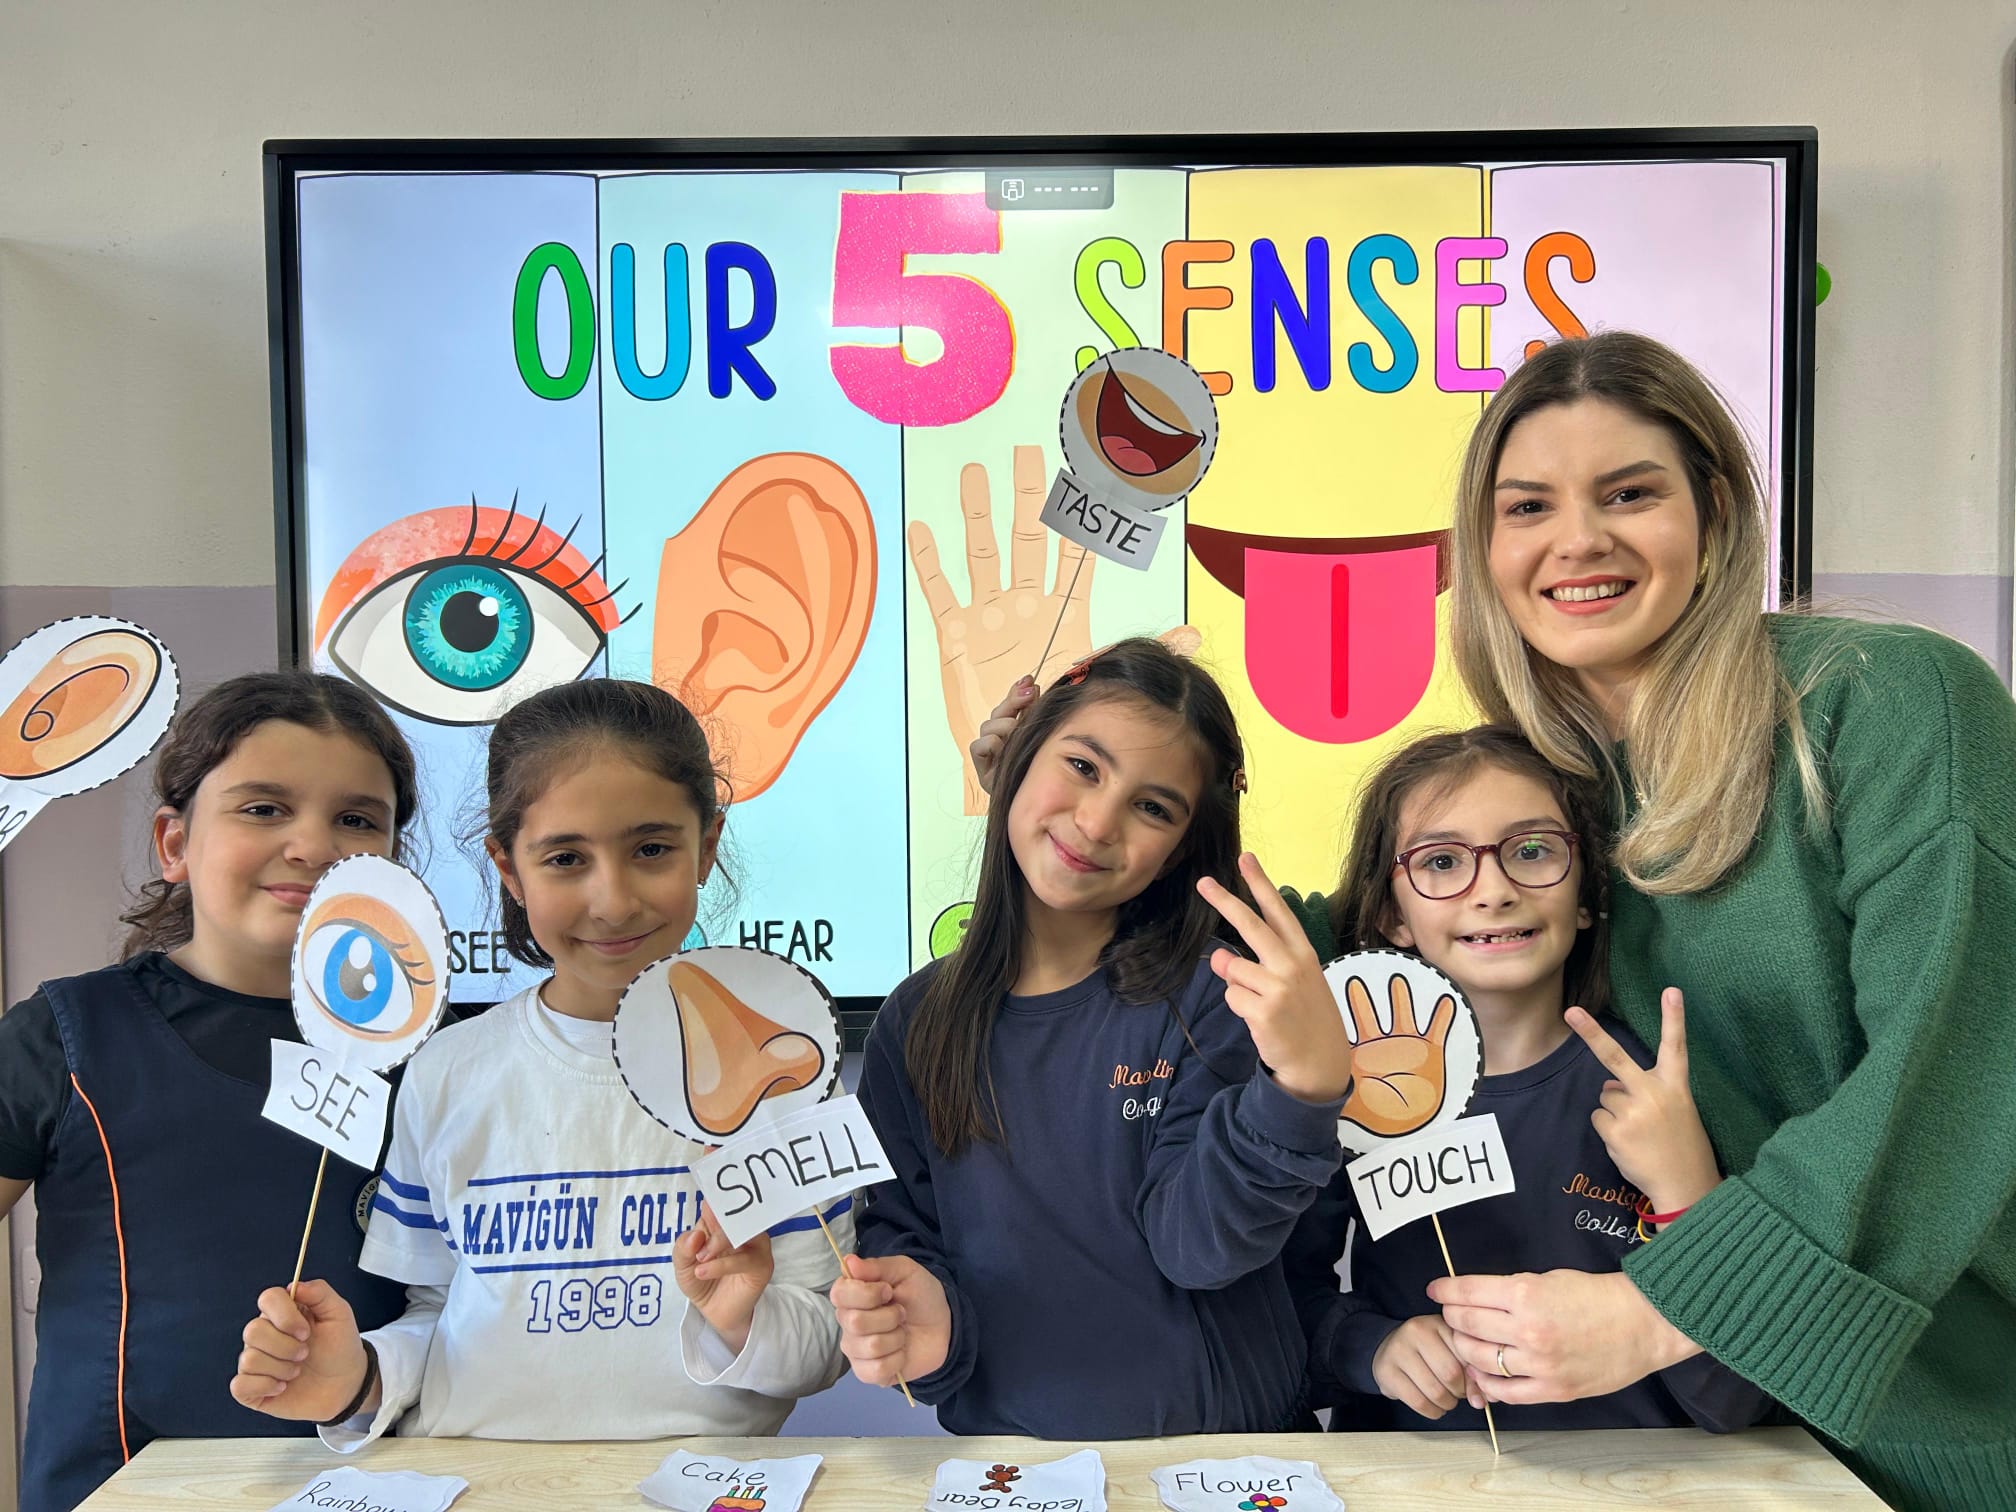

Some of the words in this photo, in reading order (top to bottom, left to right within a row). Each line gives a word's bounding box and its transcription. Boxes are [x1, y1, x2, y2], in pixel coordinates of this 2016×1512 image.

[513, 241, 777, 401] OUR
[829, 188, 1017, 428] 5
[1073, 232, 1597, 397] SENSES
[1057, 476, 1152, 555] TASTE
[449, 930, 511, 974] SEE
[740, 919, 833, 962] HEAR
[290, 1058, 369, 1141] SEE
[716, 1123, 879, 1216] SMELL
[1358, 1141, 1494, 1210] TOUCH
[462, 1183, 599, 1255] MAVİGÜN
[527, 1273, 663, 1333] 1998
[681, 1462, 766, 1486] Cake
[937, 1493, 1000, 1510] Bear
[1175, 1471, 1303, 1493] Flower
